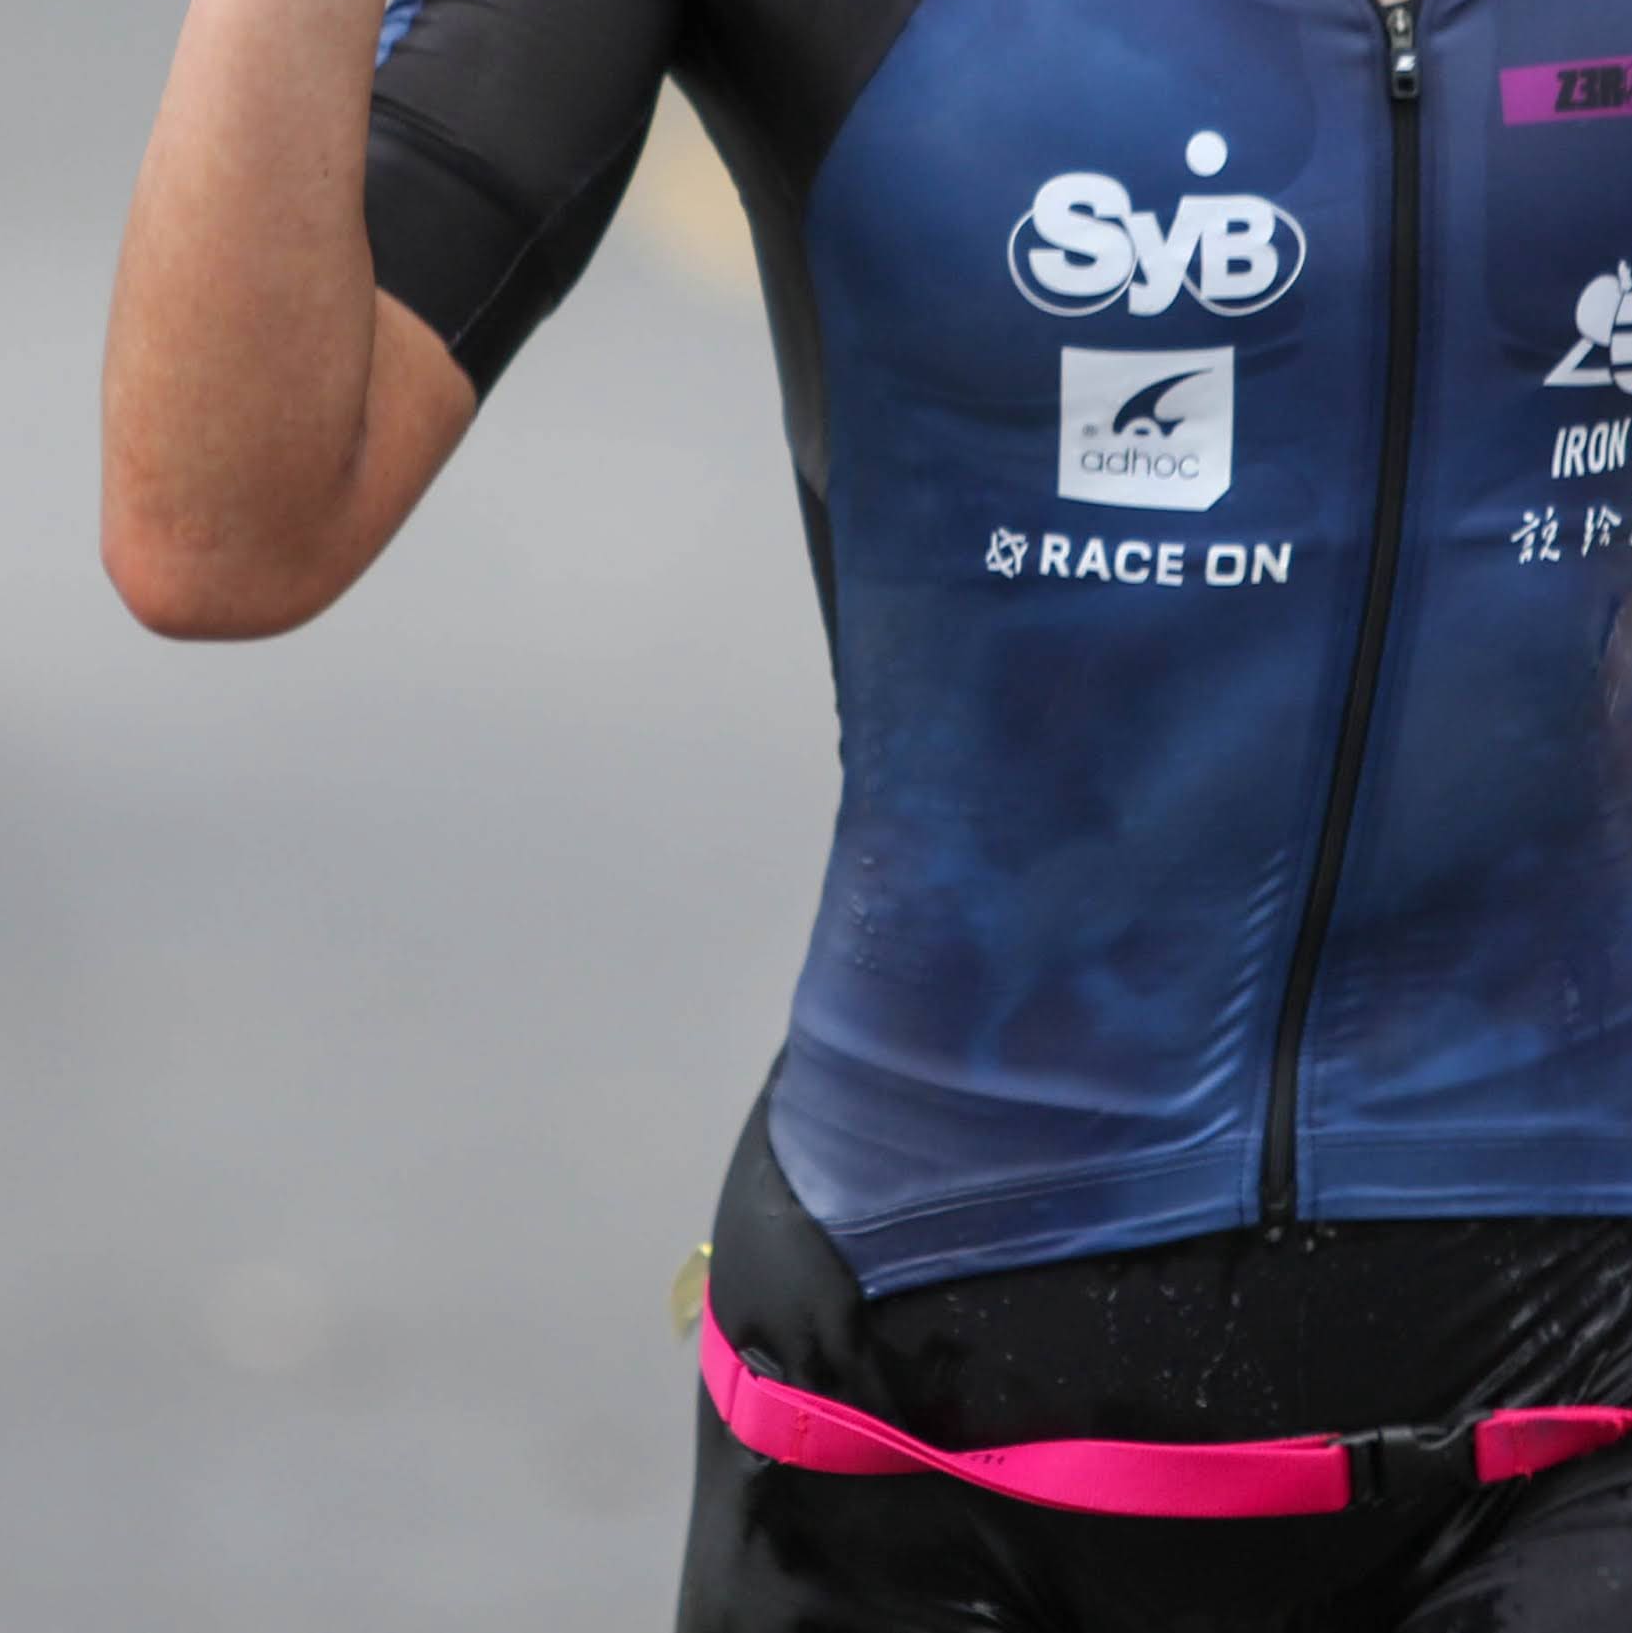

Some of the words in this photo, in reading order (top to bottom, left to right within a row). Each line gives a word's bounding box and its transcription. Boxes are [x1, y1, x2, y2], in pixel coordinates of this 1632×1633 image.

[1080, 447, 1201, 481] adhoc
[1551, 416, 1632, 480] IRON
[1038, 533, 1186, 588] RACE
[1204, 542, 1293, 588] ON
